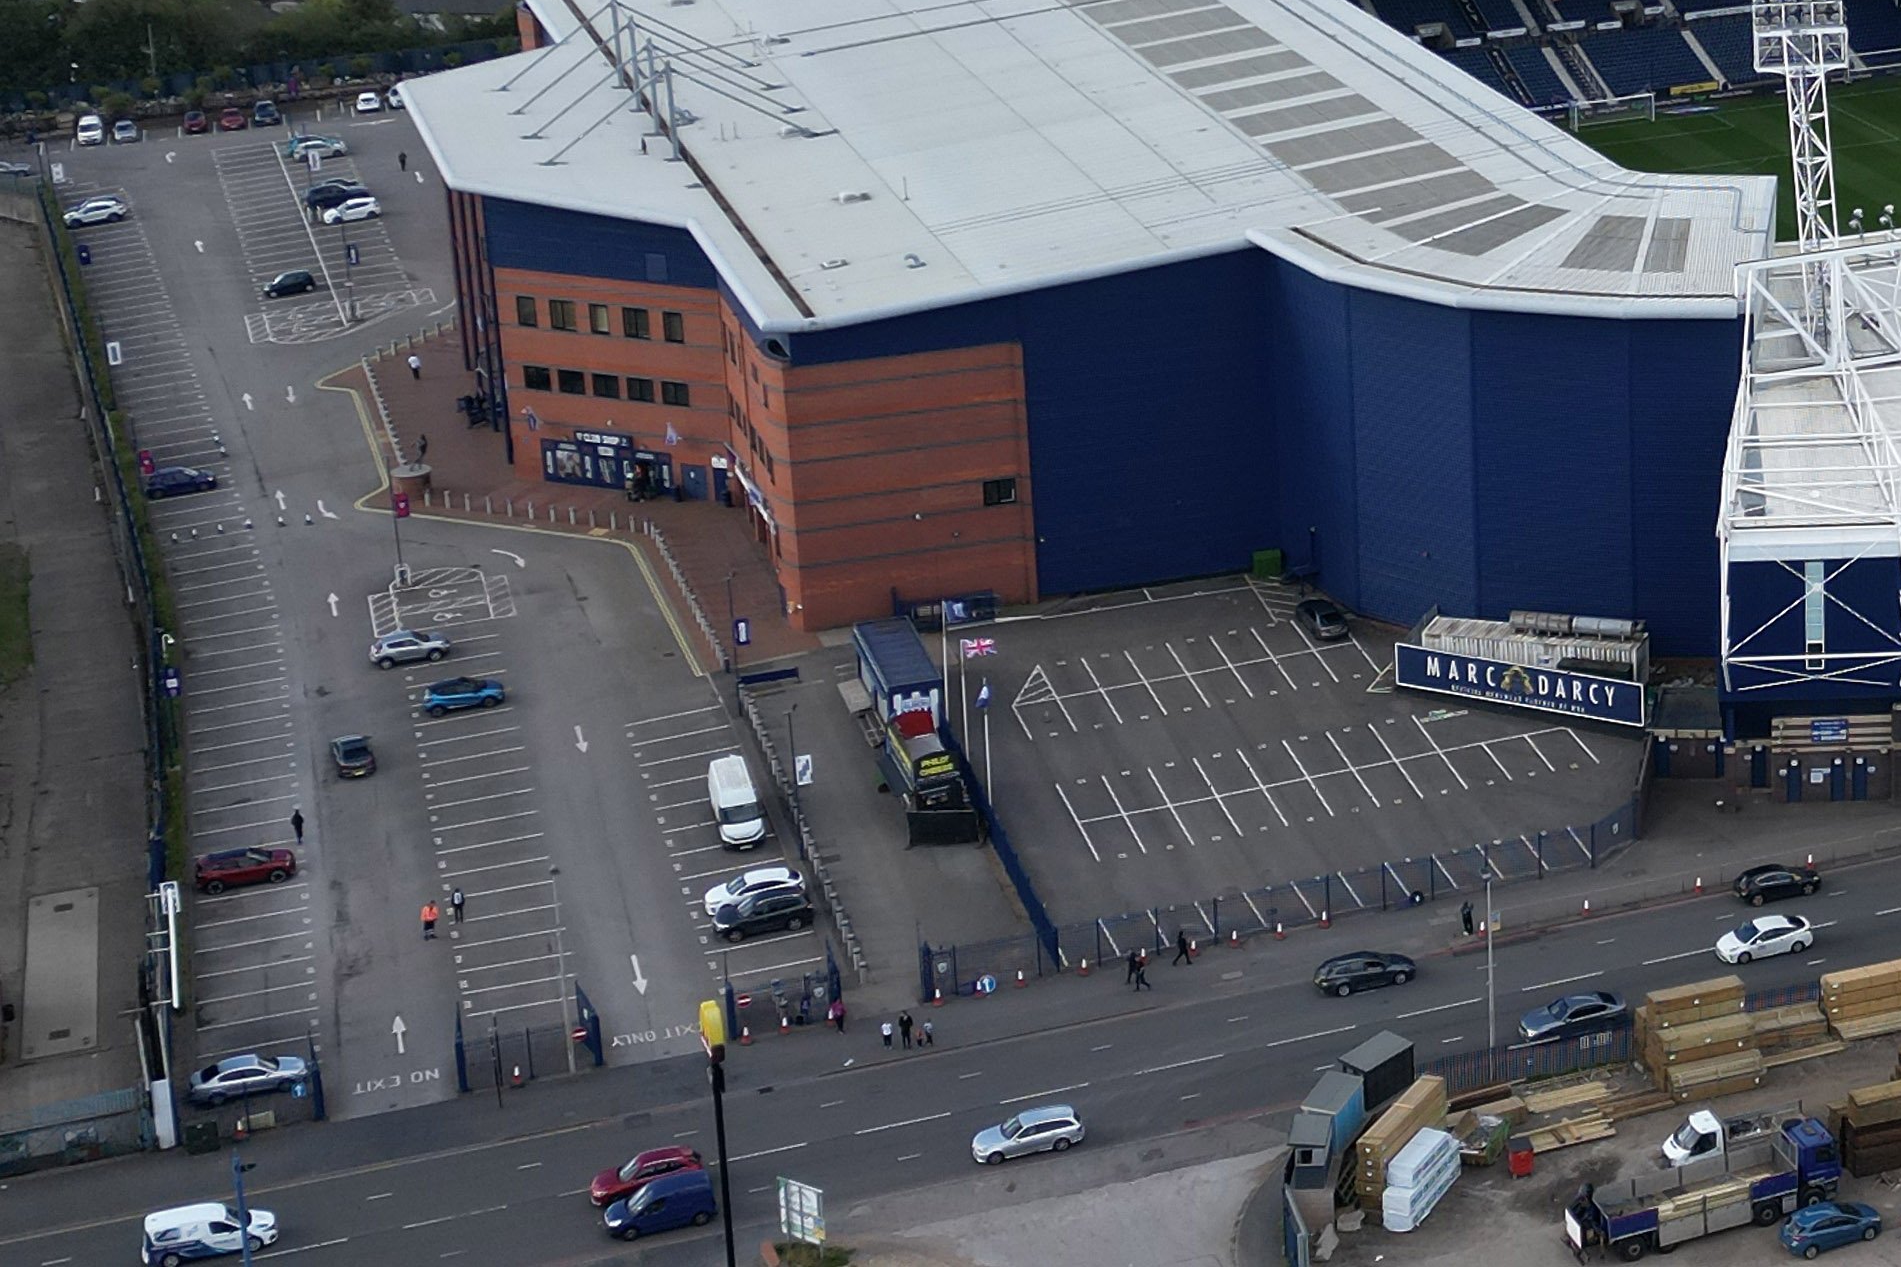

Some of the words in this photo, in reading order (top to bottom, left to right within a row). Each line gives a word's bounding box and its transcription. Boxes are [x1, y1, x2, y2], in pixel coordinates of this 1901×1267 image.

[1426, 655, 1496, 688] MARC
[1538, 675, 1616, 708] DARCY
[612, 1030, 657, 1047] ONLY
[663, 1023, 699, 1039] XIT
[410, 1067, 440, 1083] NO
[352, 1074, 401, 1095] EXIT
